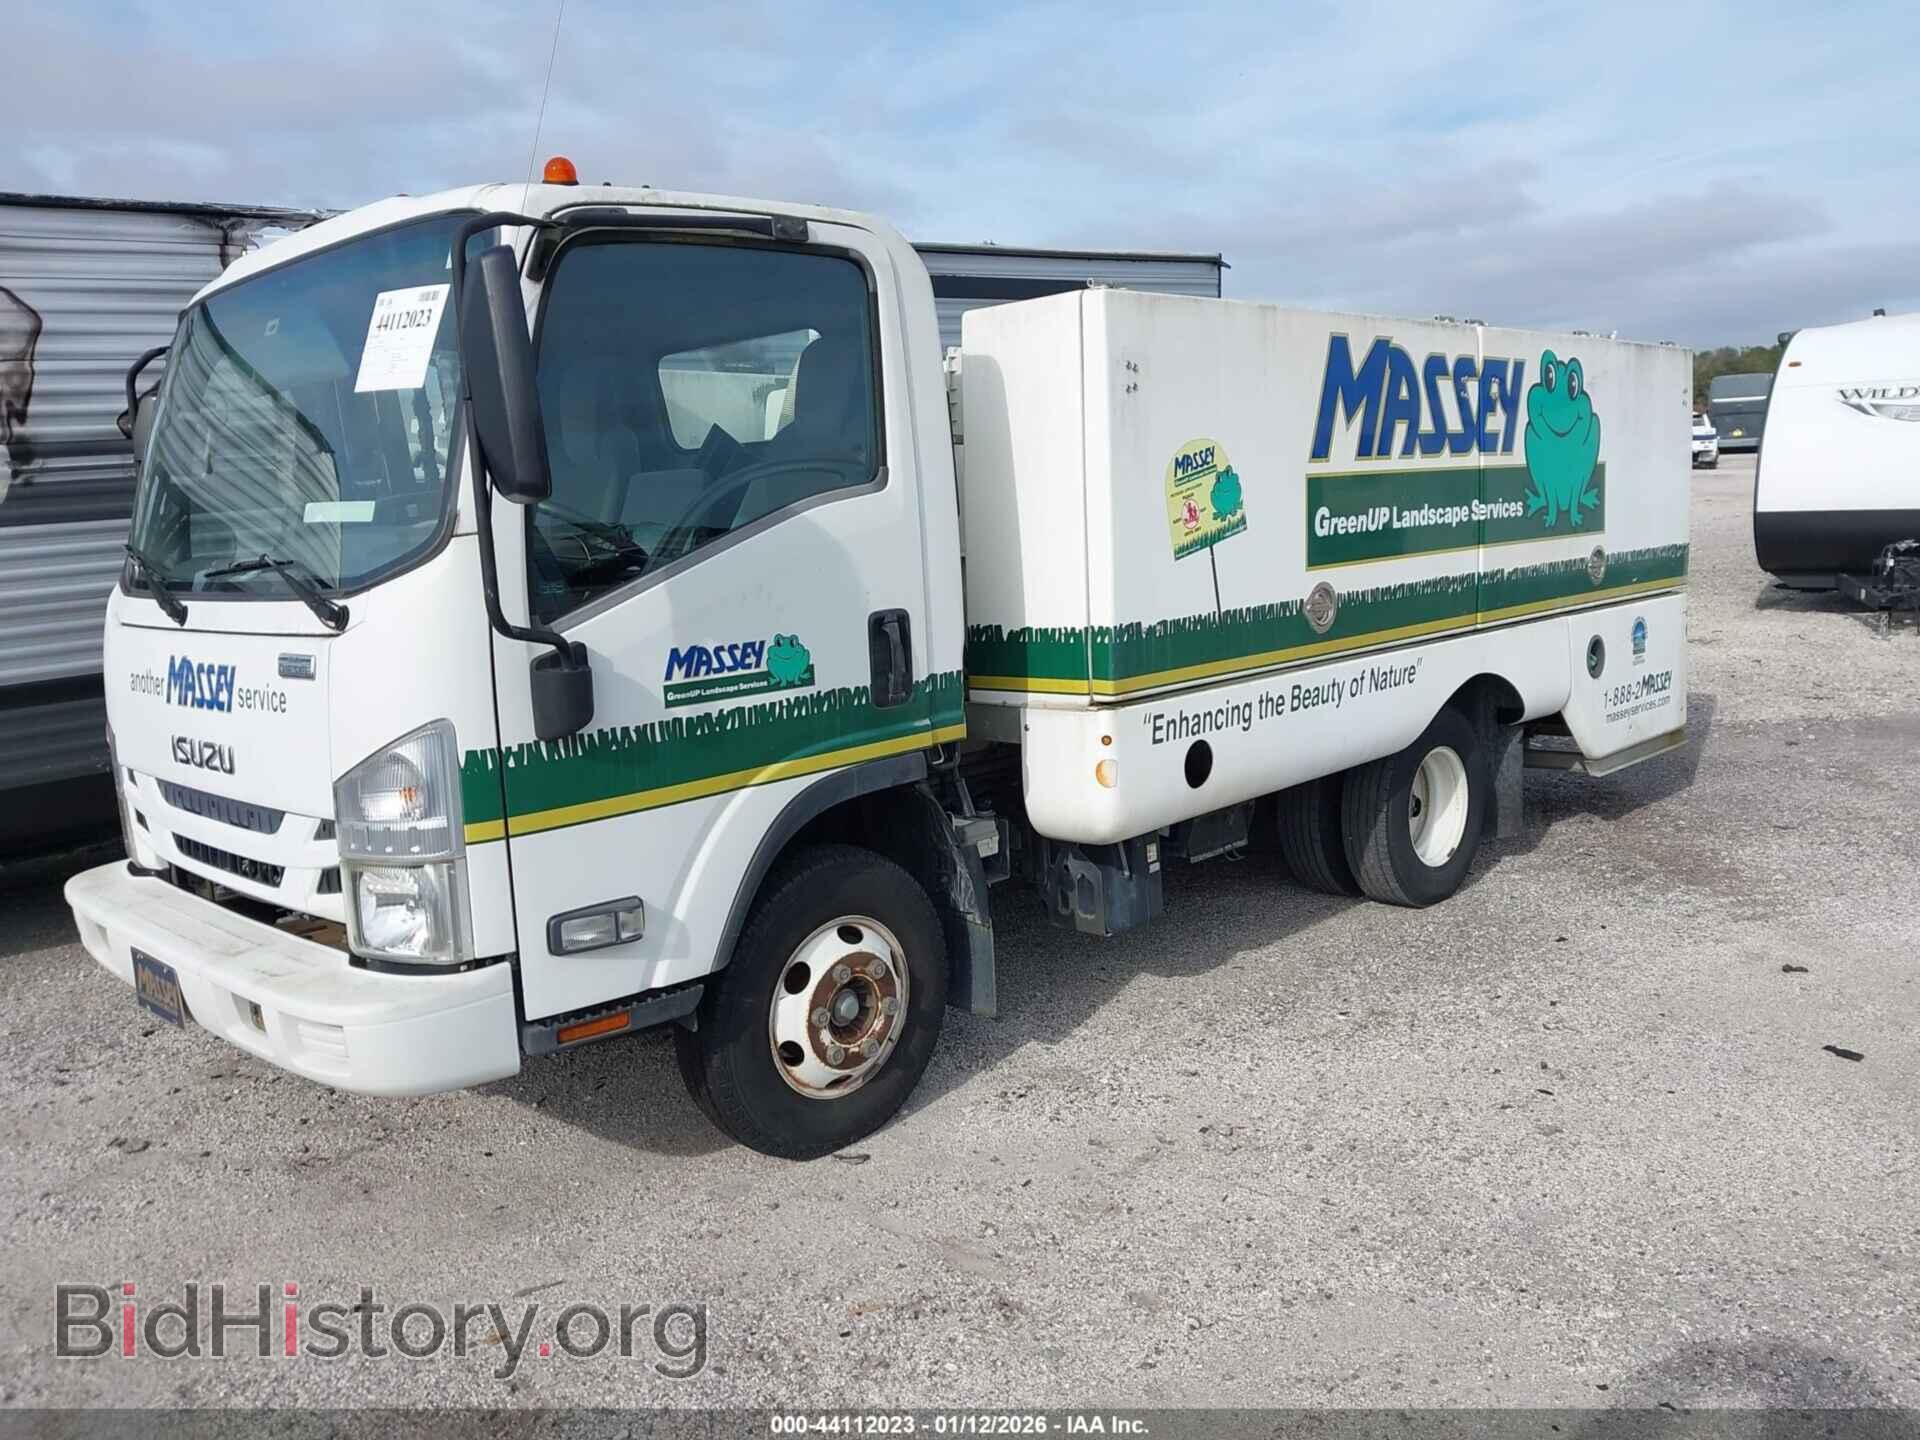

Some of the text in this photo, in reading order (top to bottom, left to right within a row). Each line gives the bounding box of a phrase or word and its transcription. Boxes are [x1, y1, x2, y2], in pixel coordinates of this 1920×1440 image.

[376, 308, 433, 332] 44112023
[1308, 332, 1529, 463] MASSEY
[1837, 386, 1920, 400] WILD
[1174, 445, 1216, 478] MASSEY
[1314, 498, 1524, 537] GreenUP Landscape Services
[665, 640, 766, 681] MASSEY
[129, 655, 288, 714] another MASSEY service
[666, 680, 769, 701] GreenUP Landscape Services
[1258, 691, 1286, 720] the
[1290, 679, 1346, 713] Beauty
[1350, 672, 1366, 698] of
[1604, 669, 1673, 710] 1-888-2MASSEY
[1605, 695, 1672, 724] masseyservices.com
[171, 734, 236, 775] ISUZU
